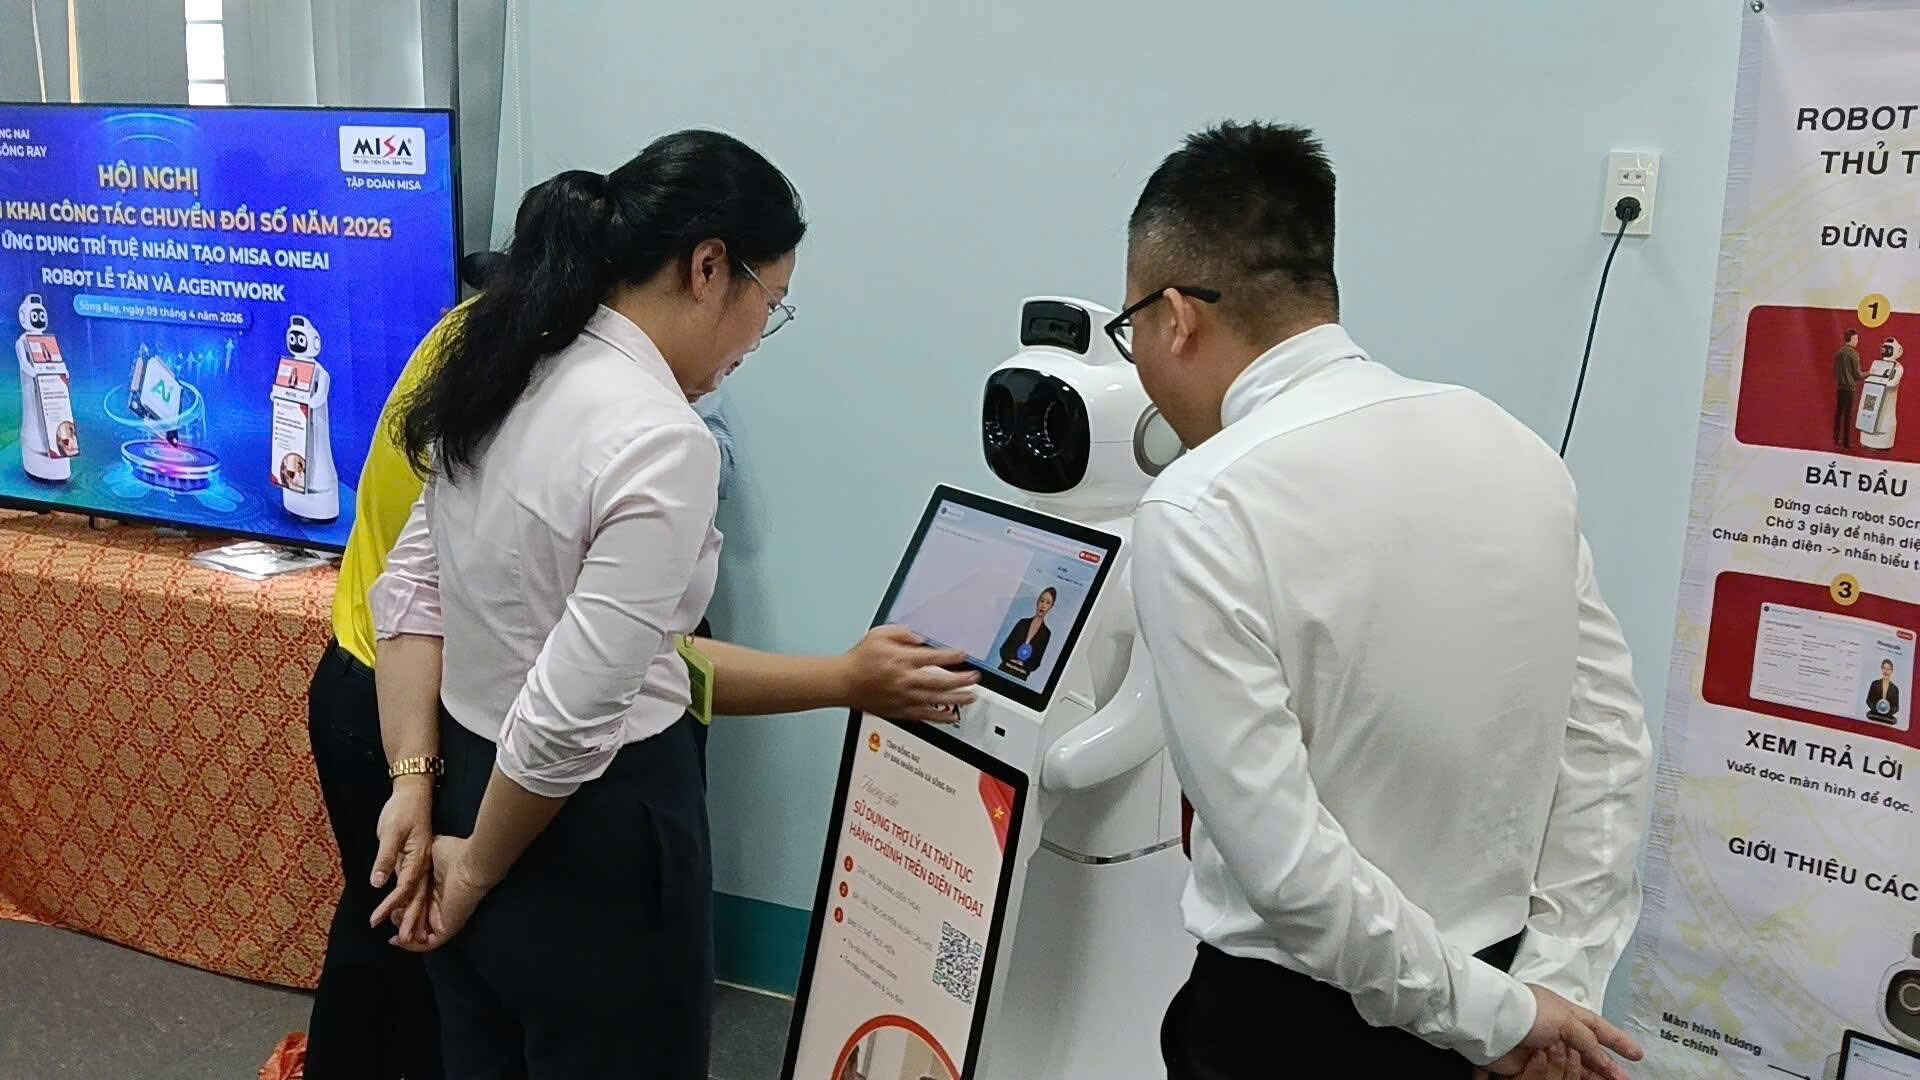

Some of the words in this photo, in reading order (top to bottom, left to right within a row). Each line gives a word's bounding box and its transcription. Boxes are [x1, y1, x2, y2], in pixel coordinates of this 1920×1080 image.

[14, 129, 30, 139] NAI
[1797, 105, 1918, 131] ROBOT
[27, 145, 47, 157] RAY
[353, 134, 412, 158] MISA
[1820, 141, 1889, 174] THỦ
[98, 160, 137, 193] HỘI
[144, 166, 199, 195] NGHỊ
[346, 176, 364, 190] TẬP
[366, 176, 395, 189] ĐOÀN
[397, 180, 421, 190] MISA
[6, 201, 46, 221] KHAI
[50, 199, 99, 223] CÔNG
[102, 202, 136, 225] TÁC
[141, 202, 216, 230] CHUYỂN
[220, 204, 256, 231] ĐỔI
[260, 205, 287, 233] SỐ
[292, 209, 338, 235] NĂM
[343, 216, 392, 238] 2026
[36, 234, 79, 256] DỤNG
[81, 235, 105, 255] TRÍ
[108, 237, 139, 261] TUỆ
[142, 239, 188, 260] NHÂN
[192, 244, 225, 266] TẠO
[229, 247, 272, 267] MISA
[275, 250, 330, 270] ONEAI
[42, 267, 93, 287] ROBOT
[97, 266, 115, 289] LỄ
[117, 270, 148, 291] TÂN
[152, 272, 174, 293] VÀ
[178, 277, 286, 302] AGENTWORK
[123, 306, 144, 316] ngày
[147, 306, 159, 316] 09
[160, 308, 187, 320] tháng
[198, 311, 218, 321] năm
[220, 312, 244, 324] 2026
[1868, 302, 1879, 319] 1
[1806, 461, 1852, 488] BẮT
[1858, 469, 1908, 497] ĐẦU
[1774, 498, 1810, 514] Đứng
[1815, 504, 1848, 517] cách
[1852, 510, 1884, 525] robot
[1713, 528, 1748, 542] Chưa
[1753, 534, 1787, 549] nhận
[1792, 540, 1822, 554] diện
[1845, 547, 1876, 562] nhấn
[1881, 553, 1909, 569] biểu
[1766, 516, 1794, 529] Chờ
[1798, 520, 1805, 531] 3
[1809, 523, 1839, 538] giây
[1844, 524, 1860, 539] để
[1863, 532, 1894, 547] nhận
[1838, 581, 1852, 598] 3
[1745, 730, 1797, 757] XEM
[1805, 744, 1853, 770] TRẢ
[1863, 755, 1903, 780] LỜI
[1727, 759, 1756, 776] Vuốt
[1759, 768, 1785, 783] dọc
[1789, 776, 1820, 790] màn
[1825, 782, 1856, 799] hình
[1860, 790, 1879, 804] để
[1883, 797, 1914, 813] đọc.
[853, 799, 867, 817] SỬ
[866, 808, 890, 833] DỤNG
[891, 822, 910, 847] TRỢ
[909, 832, 921, 850] LÝ
[921, 842, 933, 859] AI
[933, 848, 953, 870] THỦ
[955, 861, 973, 883] TỤC
[850, 822, 874, 848] HÀNH
[874, 838, 902, 865] CHÍNH
[904, 855, 928, 881] TRÊN
[928, 870, 952, 898] ĐIỆN
[953, 887, 984, 917] THOẠI
[1728, 837, 1776, 864] GIỚI
[1784, 851, 1857, 884] THIỆU
[1865, 873, 1918, 901] CÁC
[1660, 1029, 1679, 1043] tác
[1682, 1038, 1719, 1056] chính
[1662, 1012, 1688, 1030] Màn
[1692, 1022, 1720, 1040] hình
[1724, 1034, 1763, 1056] tương
